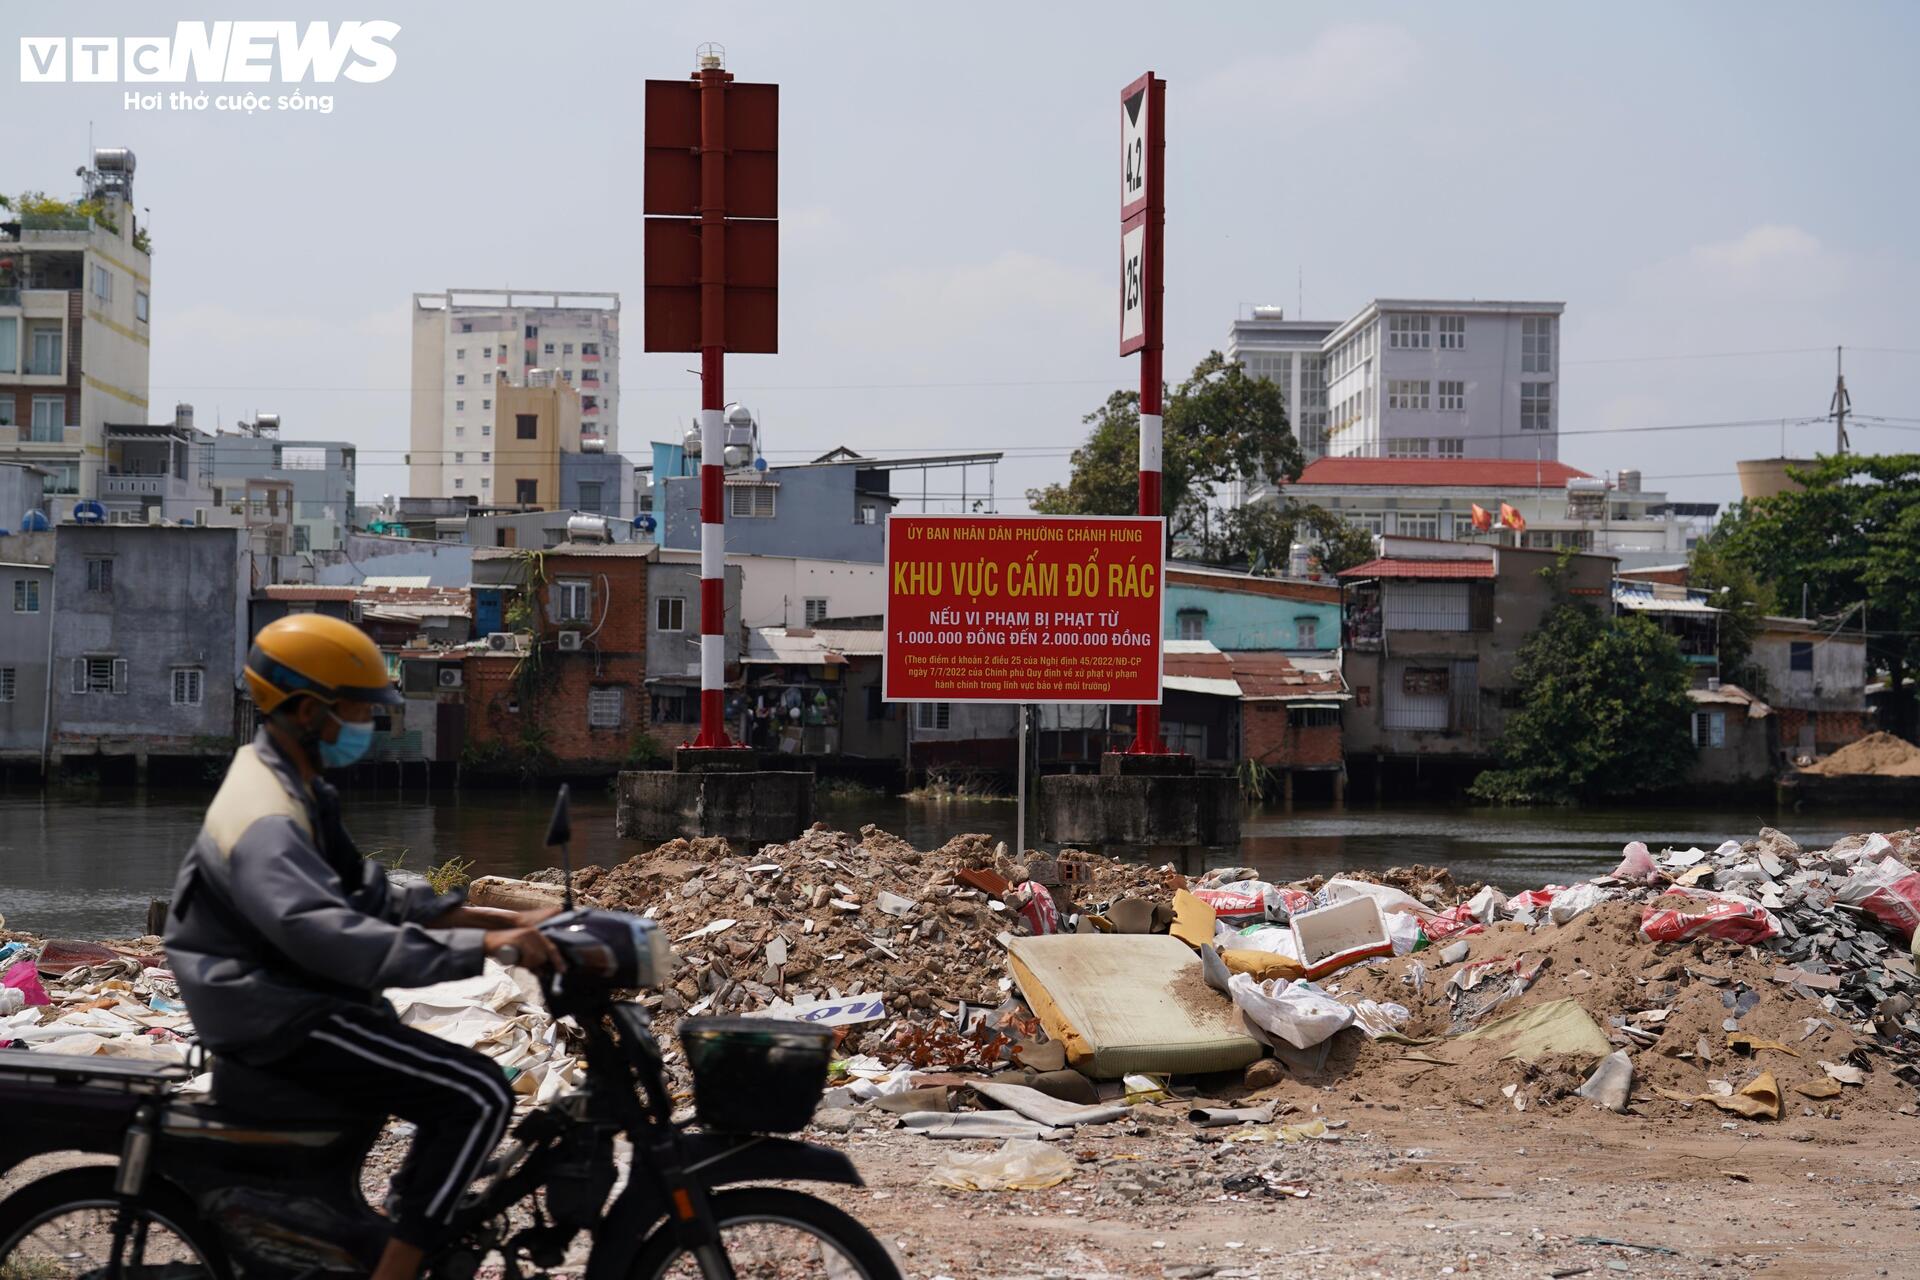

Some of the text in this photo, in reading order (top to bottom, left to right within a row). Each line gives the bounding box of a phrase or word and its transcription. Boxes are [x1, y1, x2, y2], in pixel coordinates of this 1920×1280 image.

[1126, 137, 1142, 193] 4.2
[1127, 255, 1138, 311] 25
[908, 523, 1142, 542] ỦY BAN NHÂN DÂN PHƯỜNG CHÁNH HƯNG
[895, 548, 1154, 603] KHU VỰC CẤM ĐỔ RÁC
[930, 606, 1119, 629] NẾU VI PHẠM BỊ PHẠT TỪ
[897, 627, 1150, 646] 1.000.000 ĐỒNG ĐẾN 2.000.000 ĐỒNG
[905, 655, 927, 665] (Theo
[984, 656, 990, 665] 2
[1011, 656, 1021, 664] 25
[1040, 656, 1058, 666] Nghị
[1061, 656, 1077, 667] định
[1080, 657, 1141, 665] 45/2022/NĐ-CP
[930, 667, 966, 676] 7/7/2022
[985, 668, 1007, 676] Chính
[1027, 668, 1042, 679] Quy
[1044, 668, 1061, 679] định
[1087, 669, 1104, 679] phạt
[1106, 669, 1113, 677] vi
[1116, 669, 1137, 679] phạm
[957, 680, 978, 688] chính
[981, 681, 1001, 690] trong
